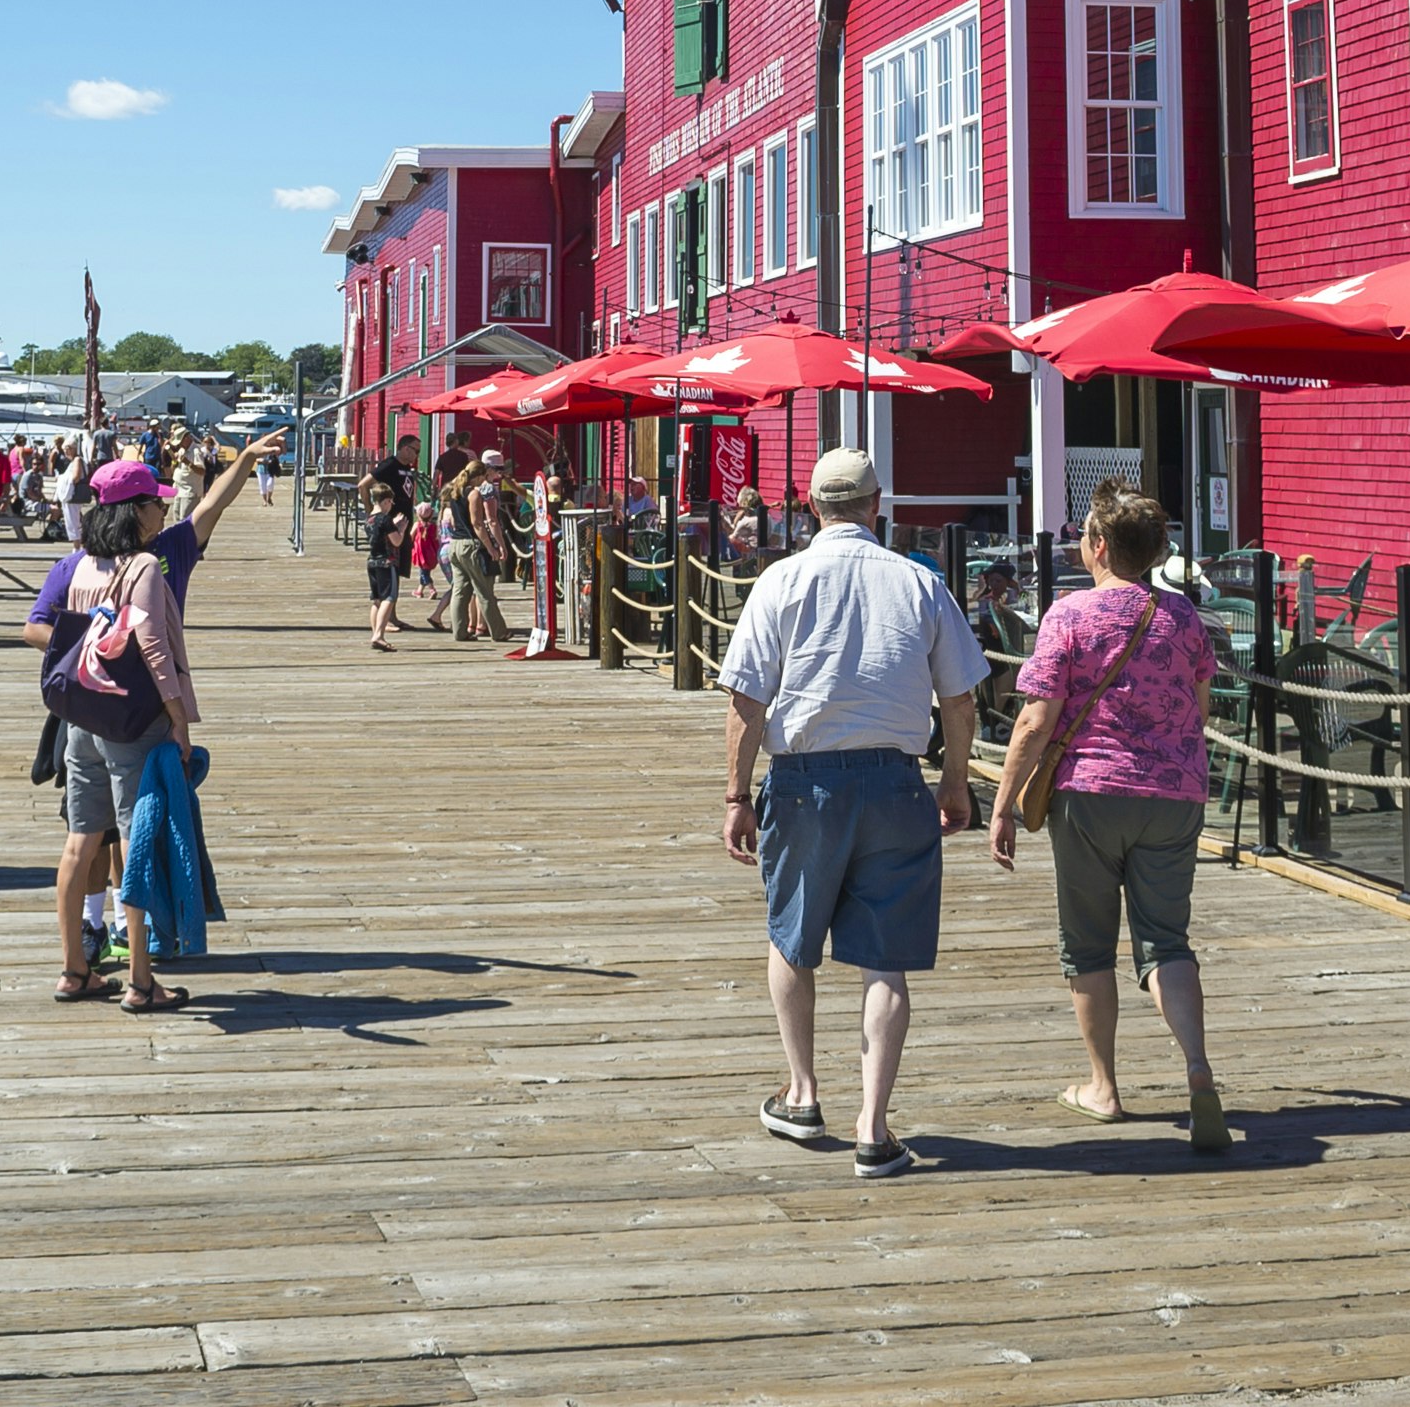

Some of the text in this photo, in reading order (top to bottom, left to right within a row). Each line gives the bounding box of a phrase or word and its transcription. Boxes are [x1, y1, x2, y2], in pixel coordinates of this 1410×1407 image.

[711, 99, 723, 137] OF
[725, 86, 740, 130] THE
[742, 56, 784, 120] ATLANTIC
